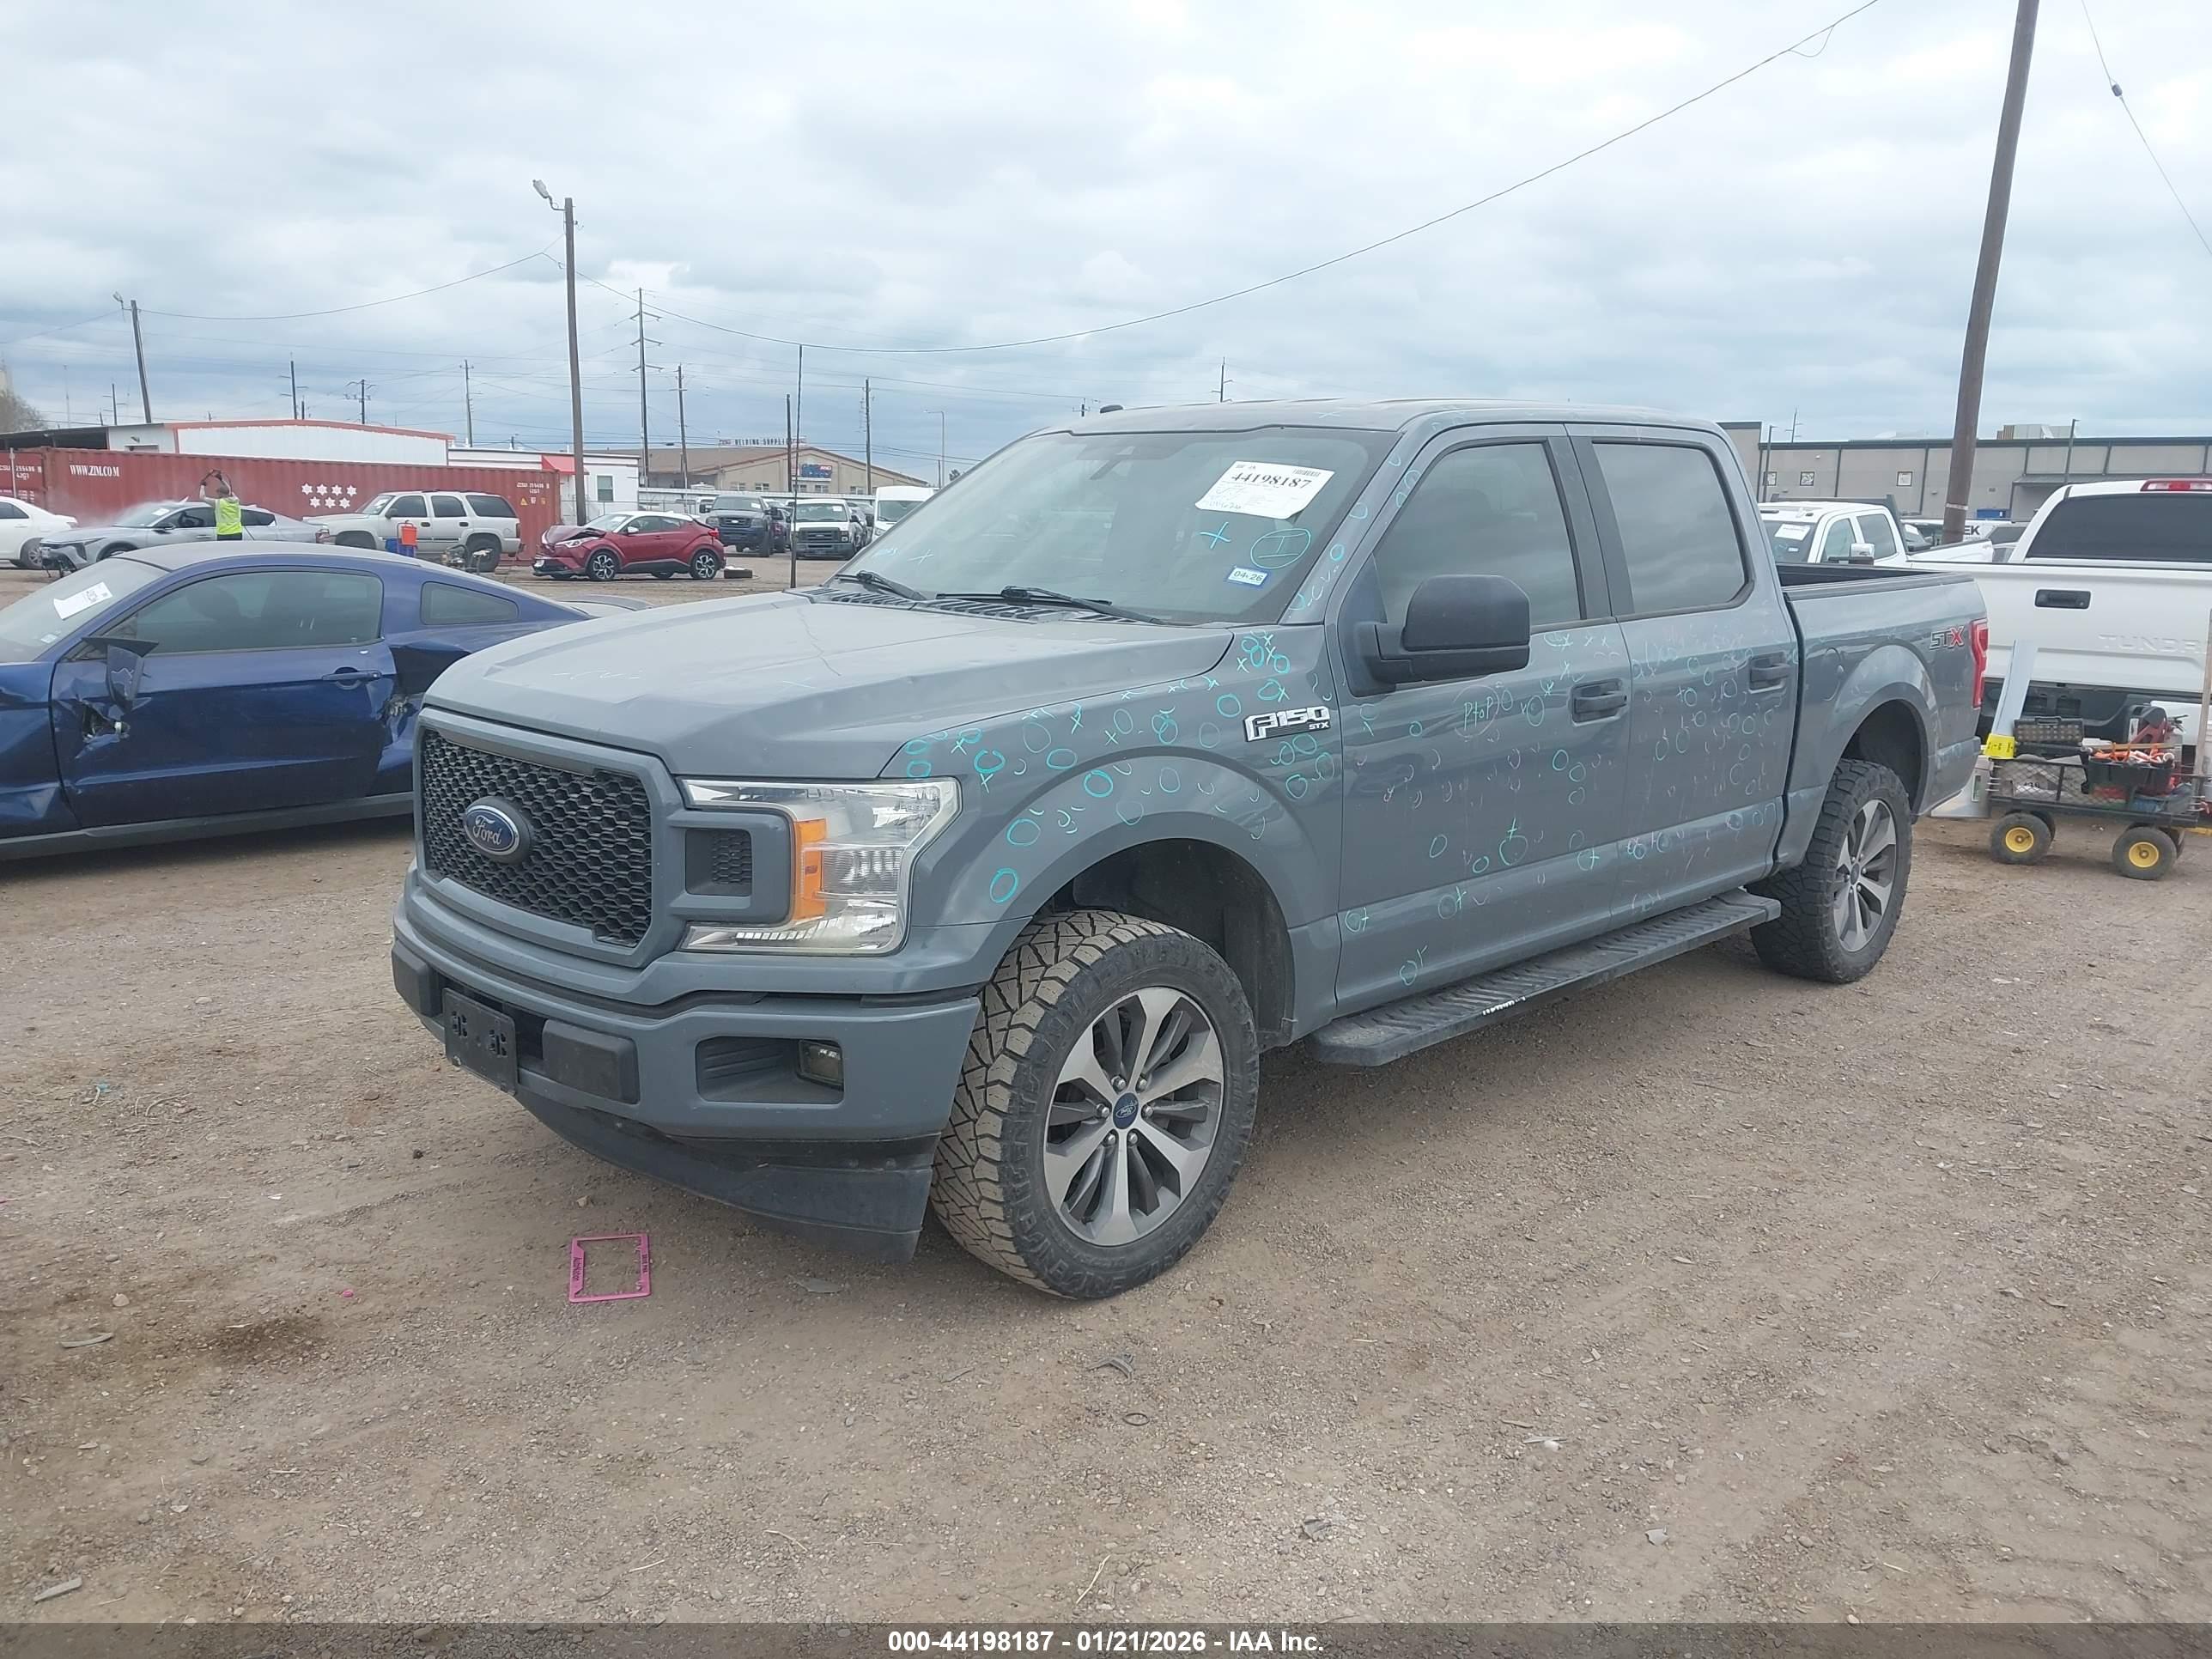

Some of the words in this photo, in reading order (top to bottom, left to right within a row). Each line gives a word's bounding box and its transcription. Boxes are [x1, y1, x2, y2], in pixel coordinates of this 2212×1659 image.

[1231, 472, 1313, 489] 44198187
[1929, 625, 1965, 650] STX
[1309, 721, 1330, 730] STX
[472, 814, 502, 846] Ford
